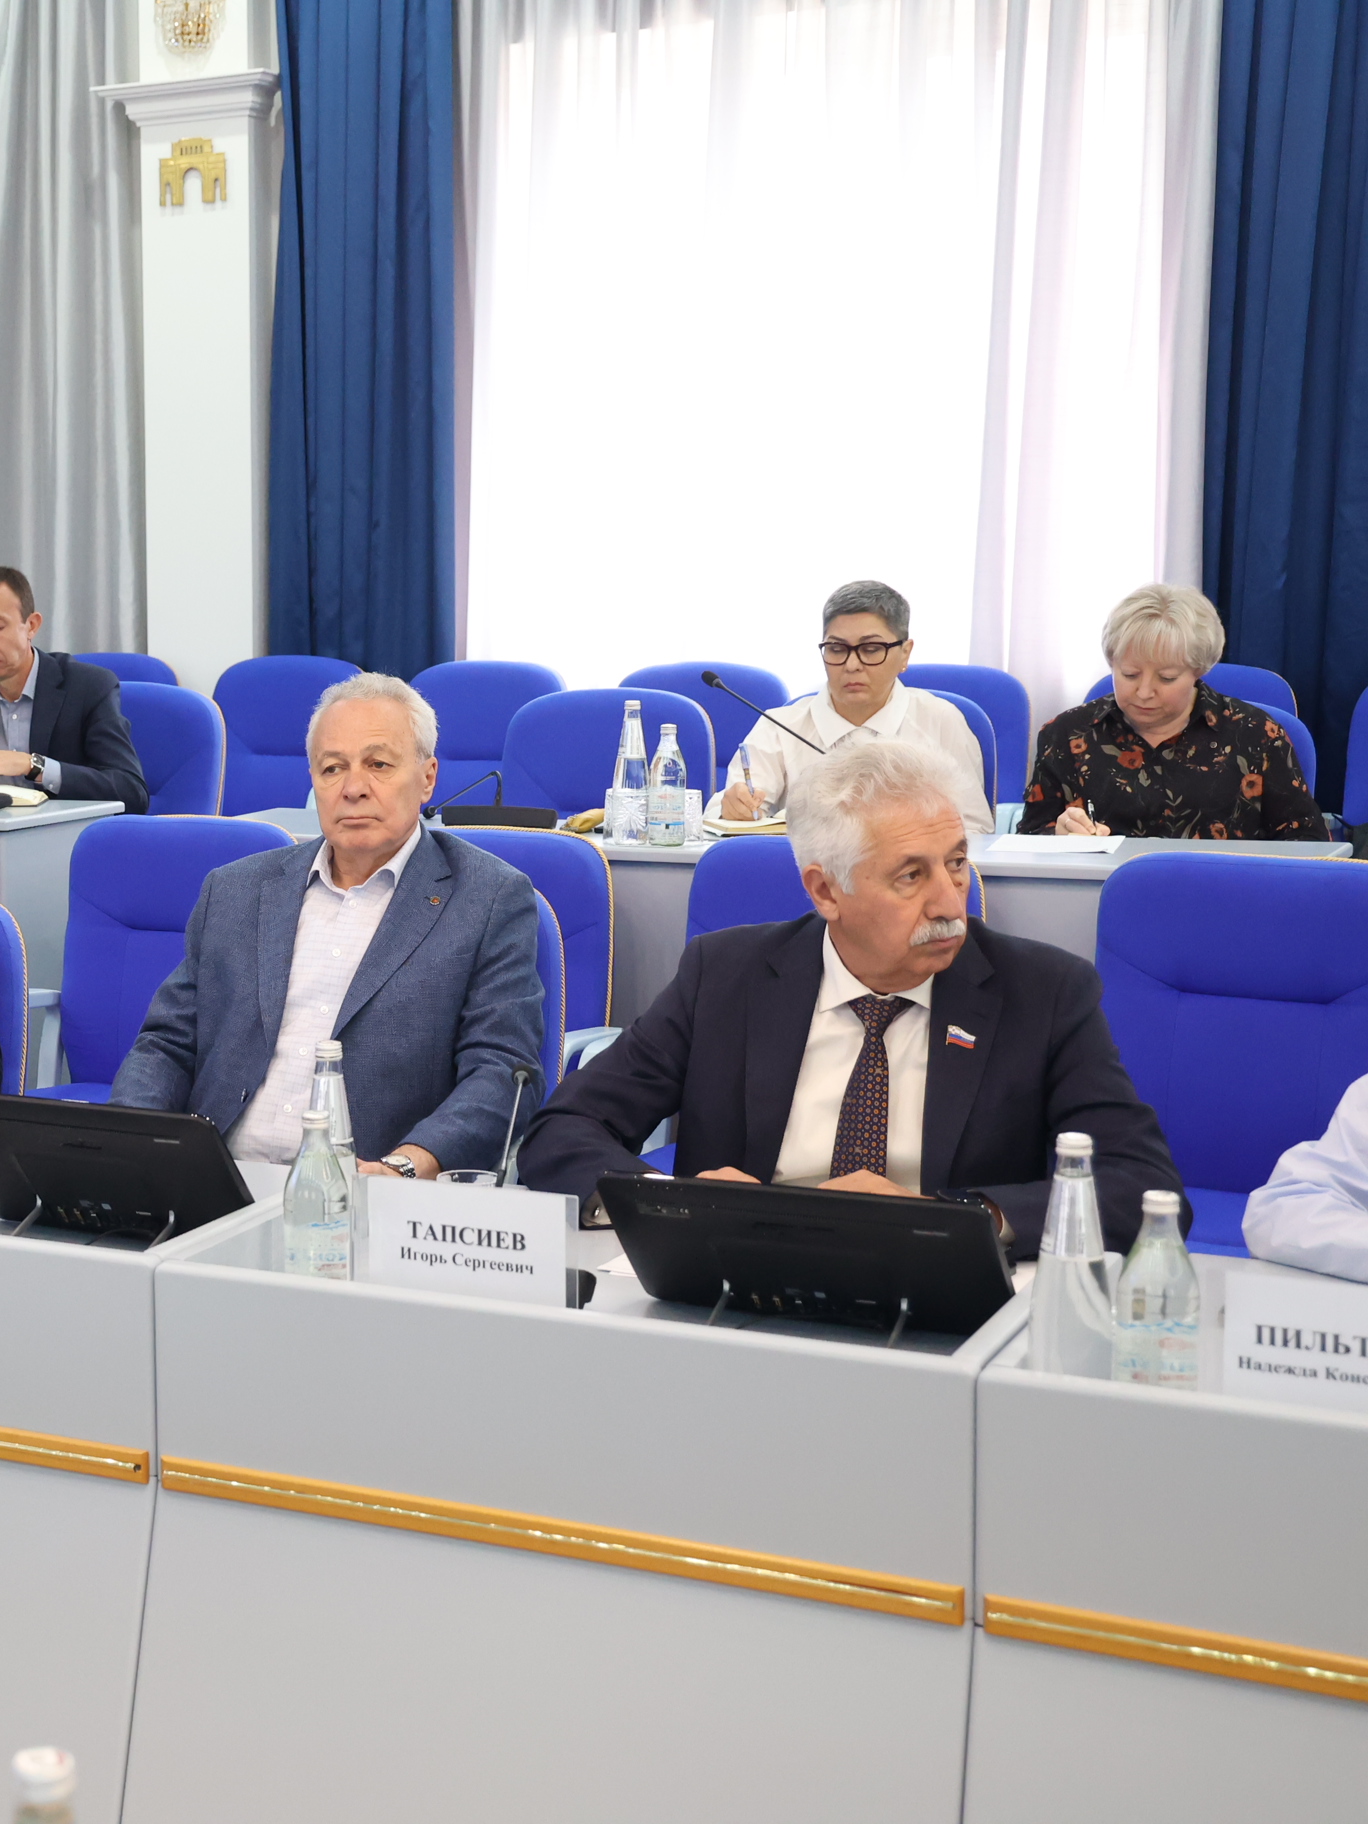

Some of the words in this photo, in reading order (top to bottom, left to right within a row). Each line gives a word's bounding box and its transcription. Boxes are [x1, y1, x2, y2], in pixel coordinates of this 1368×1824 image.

[406, 1220, 527, 1251] ТАПСИЕВ
[400, 1246, 447, 1266] Игорь
[452, 1252, 534, 1275] Сергеевич
[1238, 1355, 1318, 1379] Надежда
